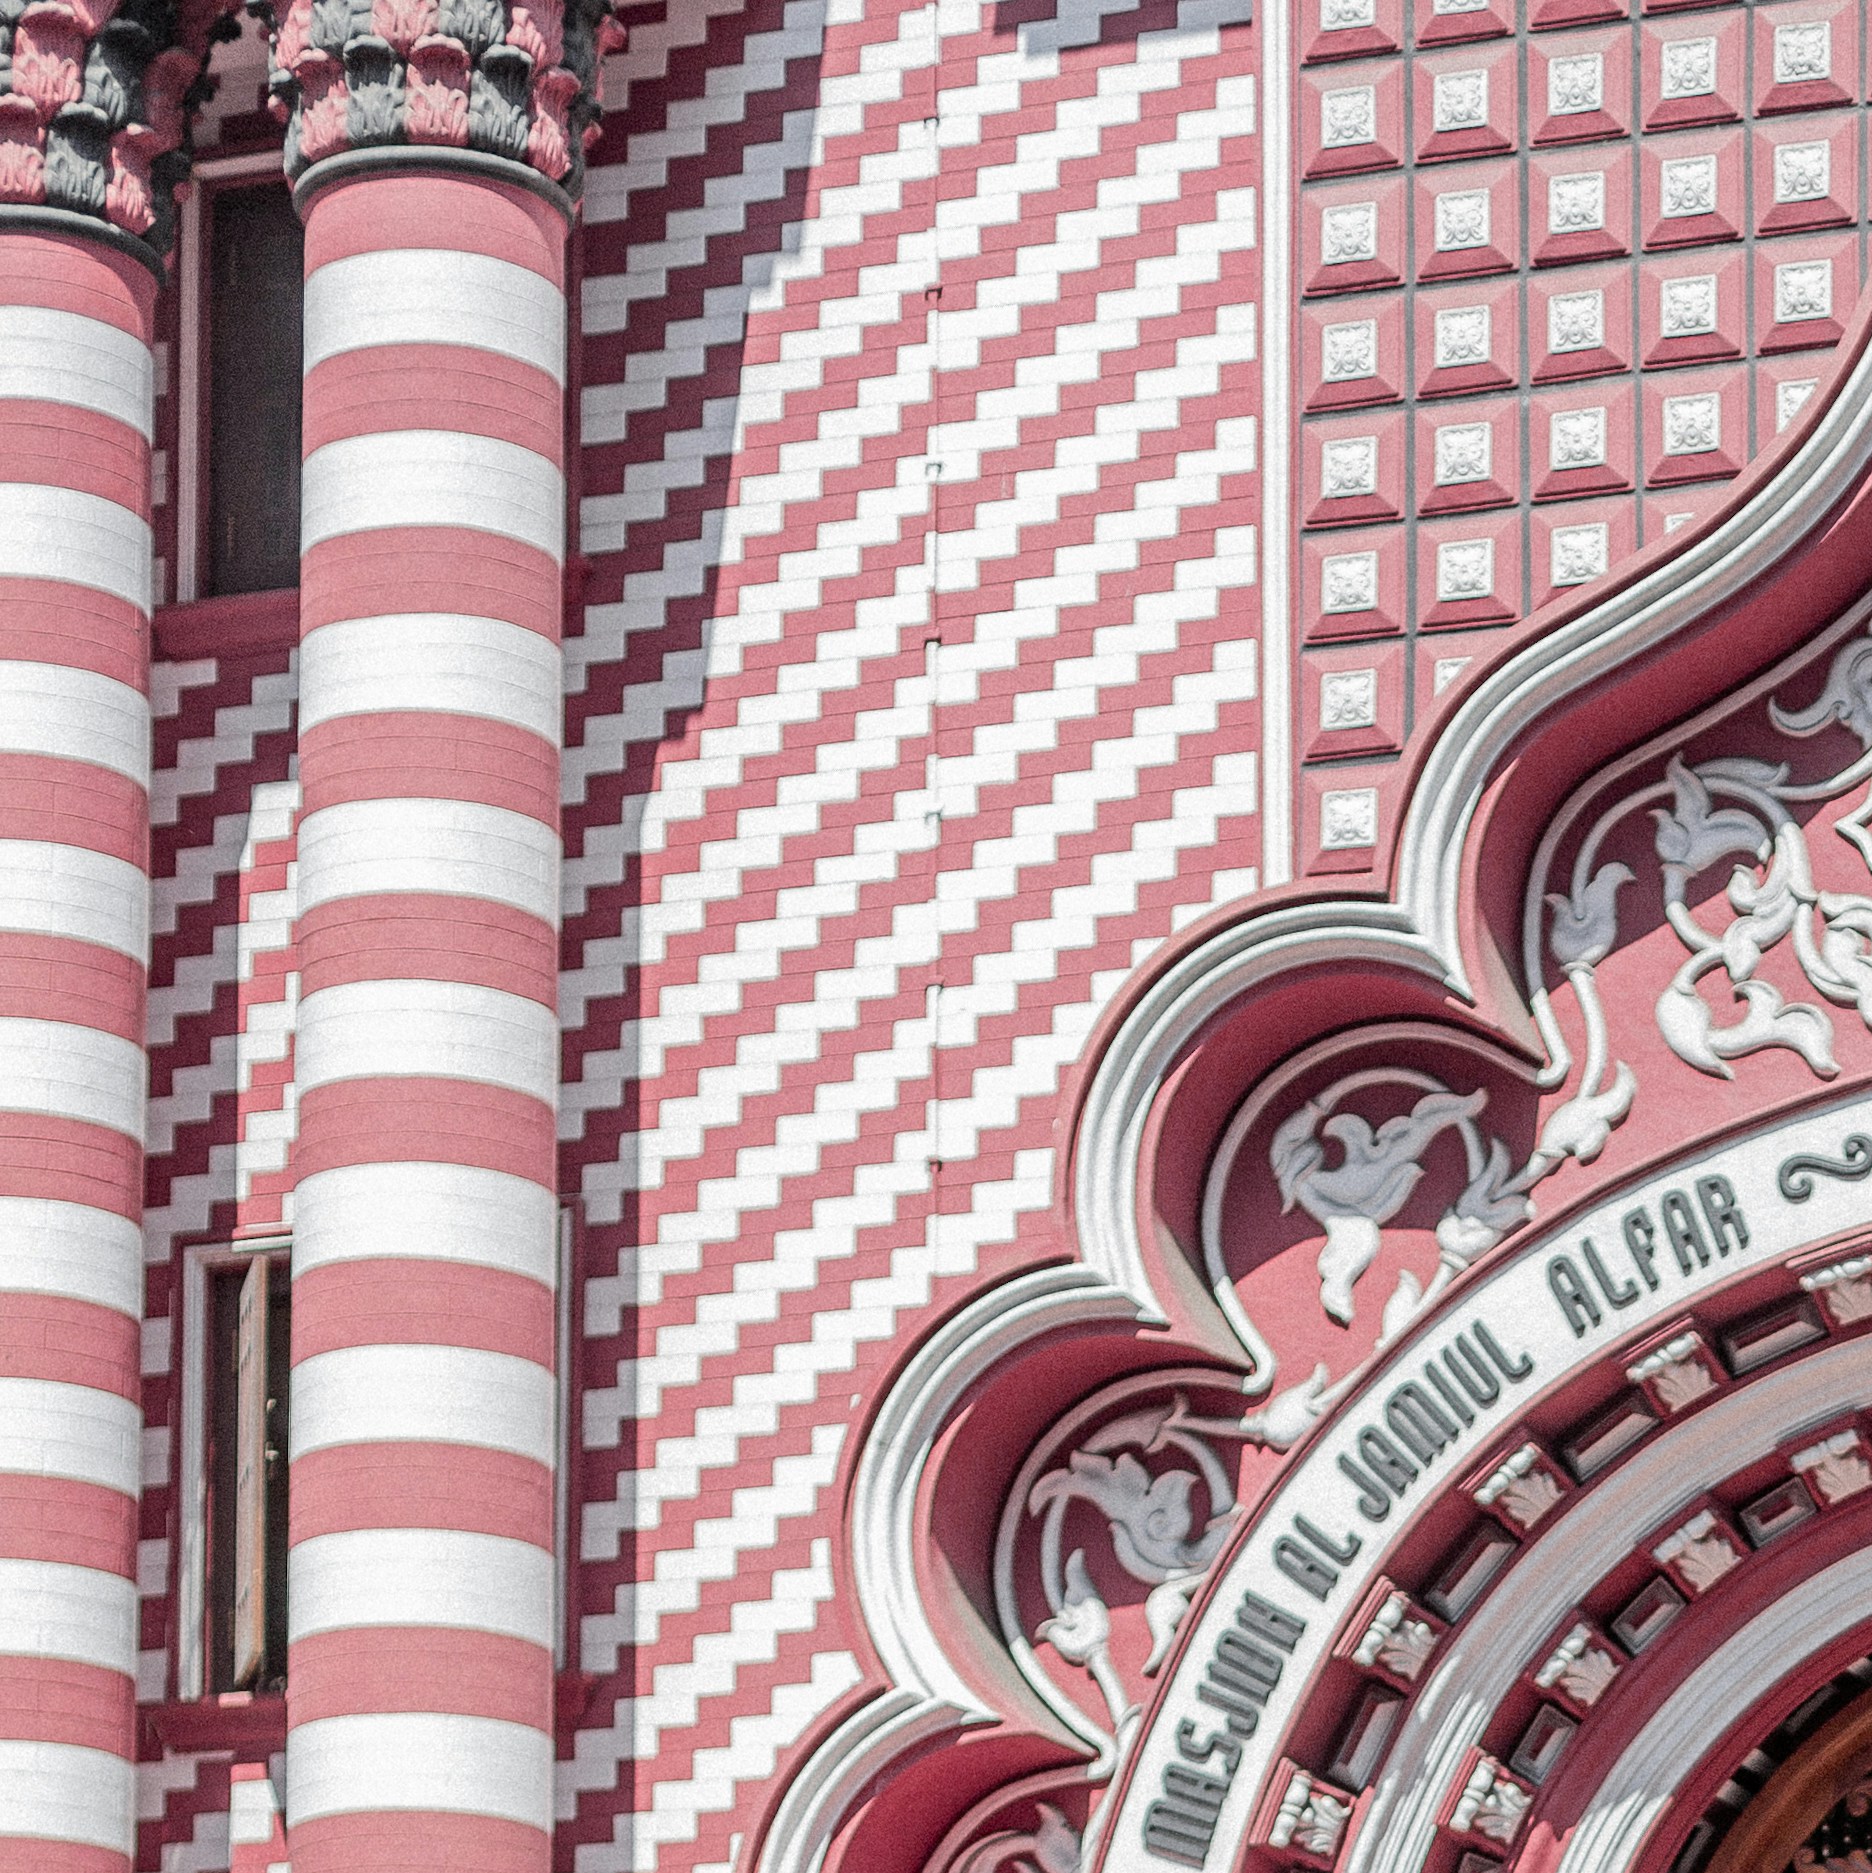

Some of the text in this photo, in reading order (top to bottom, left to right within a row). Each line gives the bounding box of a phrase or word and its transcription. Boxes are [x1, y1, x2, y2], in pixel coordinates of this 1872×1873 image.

[1142, 1588, 1308, 1871] MASJIDH
[1271, 1511, 1362, 1602] AL
[1335, 1317, 1535, 1523] JAMIUL
